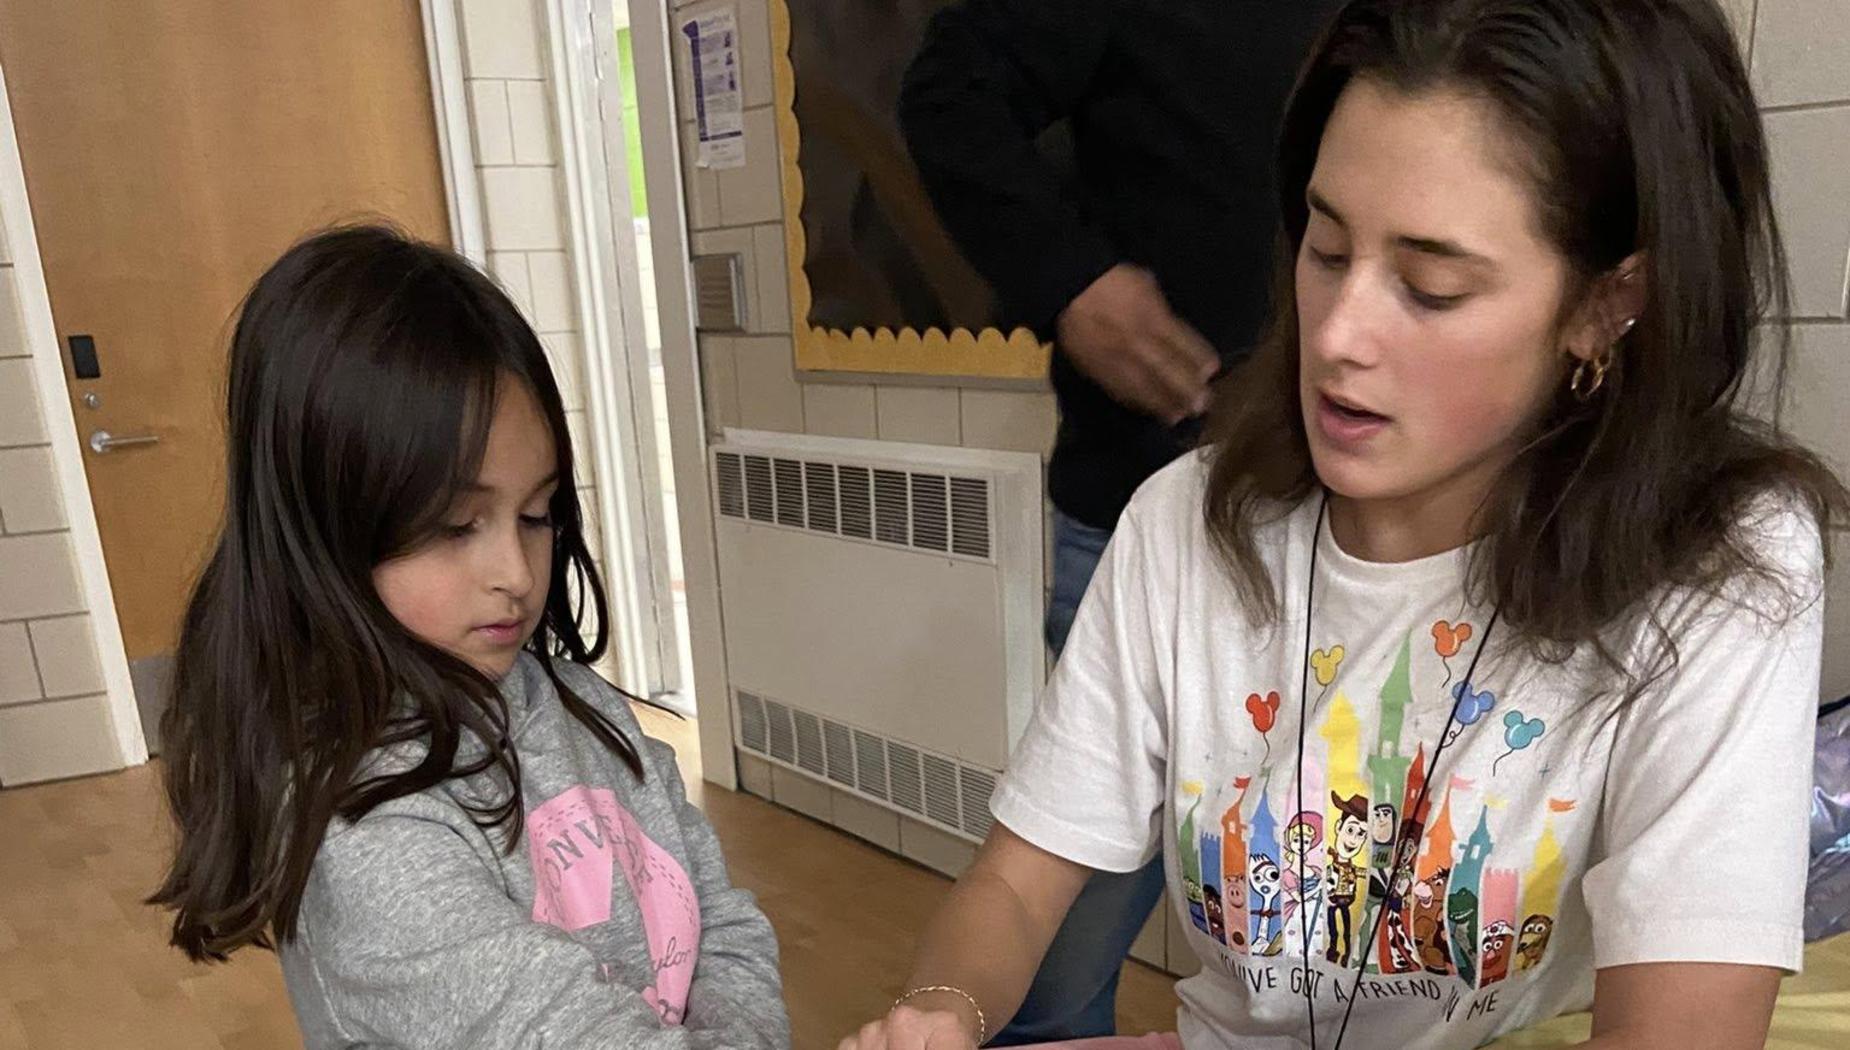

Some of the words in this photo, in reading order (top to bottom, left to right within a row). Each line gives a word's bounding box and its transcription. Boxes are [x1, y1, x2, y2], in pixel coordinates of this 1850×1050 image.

[1290, 967, 1324, 998] GOT
[1333, 978, 1350, 1003] A
[1358, 979, 1441, 1001] FRIEND
[1466, 990, 1500, 1021] ME
